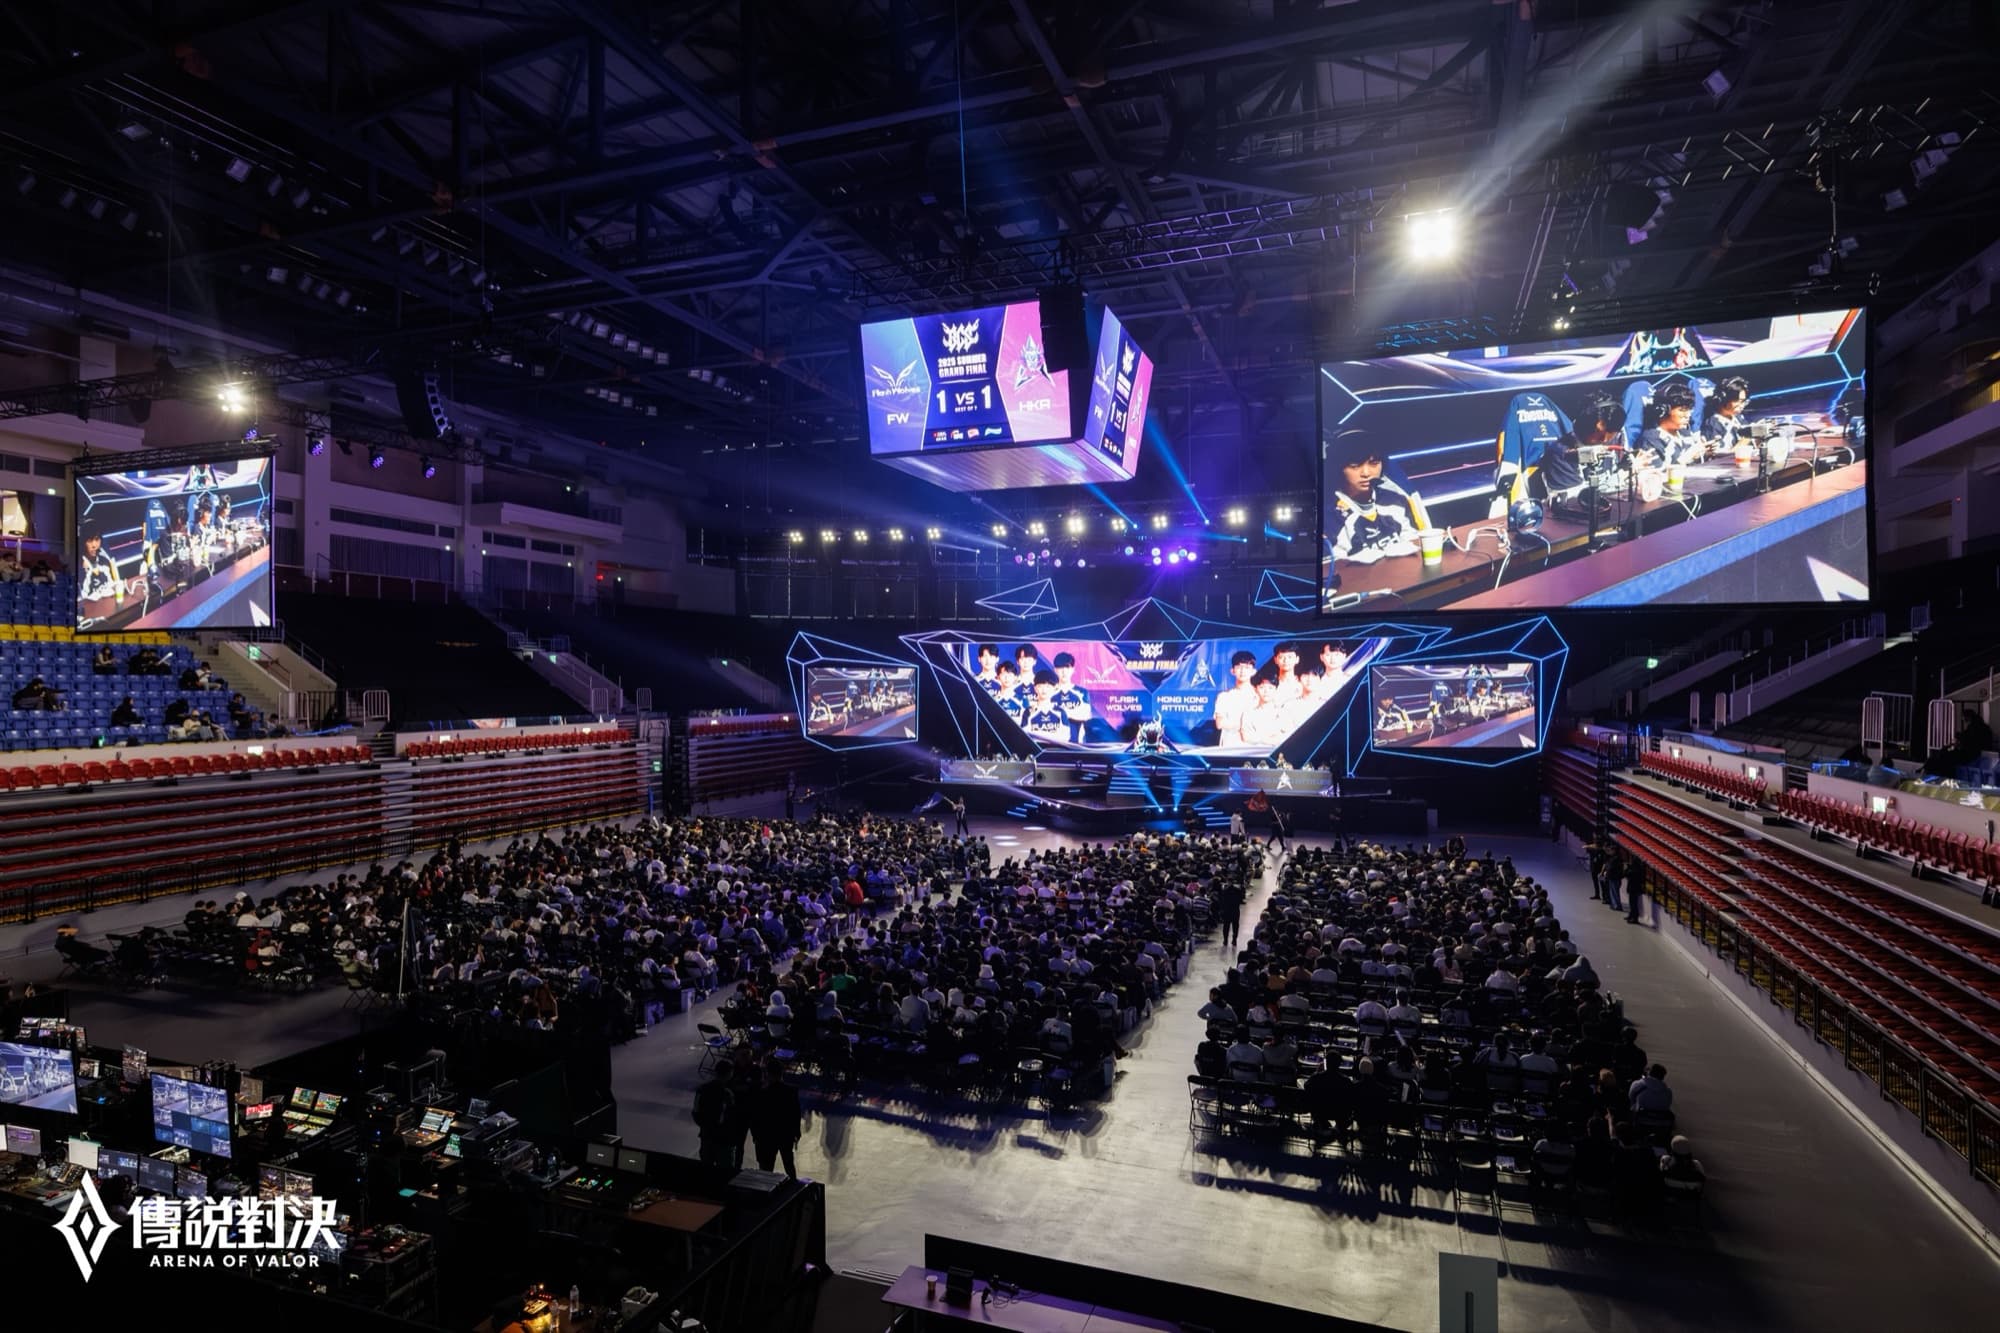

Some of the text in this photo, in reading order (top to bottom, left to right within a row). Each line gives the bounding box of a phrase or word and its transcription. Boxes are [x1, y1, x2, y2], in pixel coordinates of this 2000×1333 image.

[939, 363, 987, 378] GRAND FINAL
[936, 385, 991, 413] 1 VS 1
[887, 412, 909, 425] FW
[1105, 704, 1142, 712] WOLVES
[1161, 704, 1204, 712] ATTITUDE
